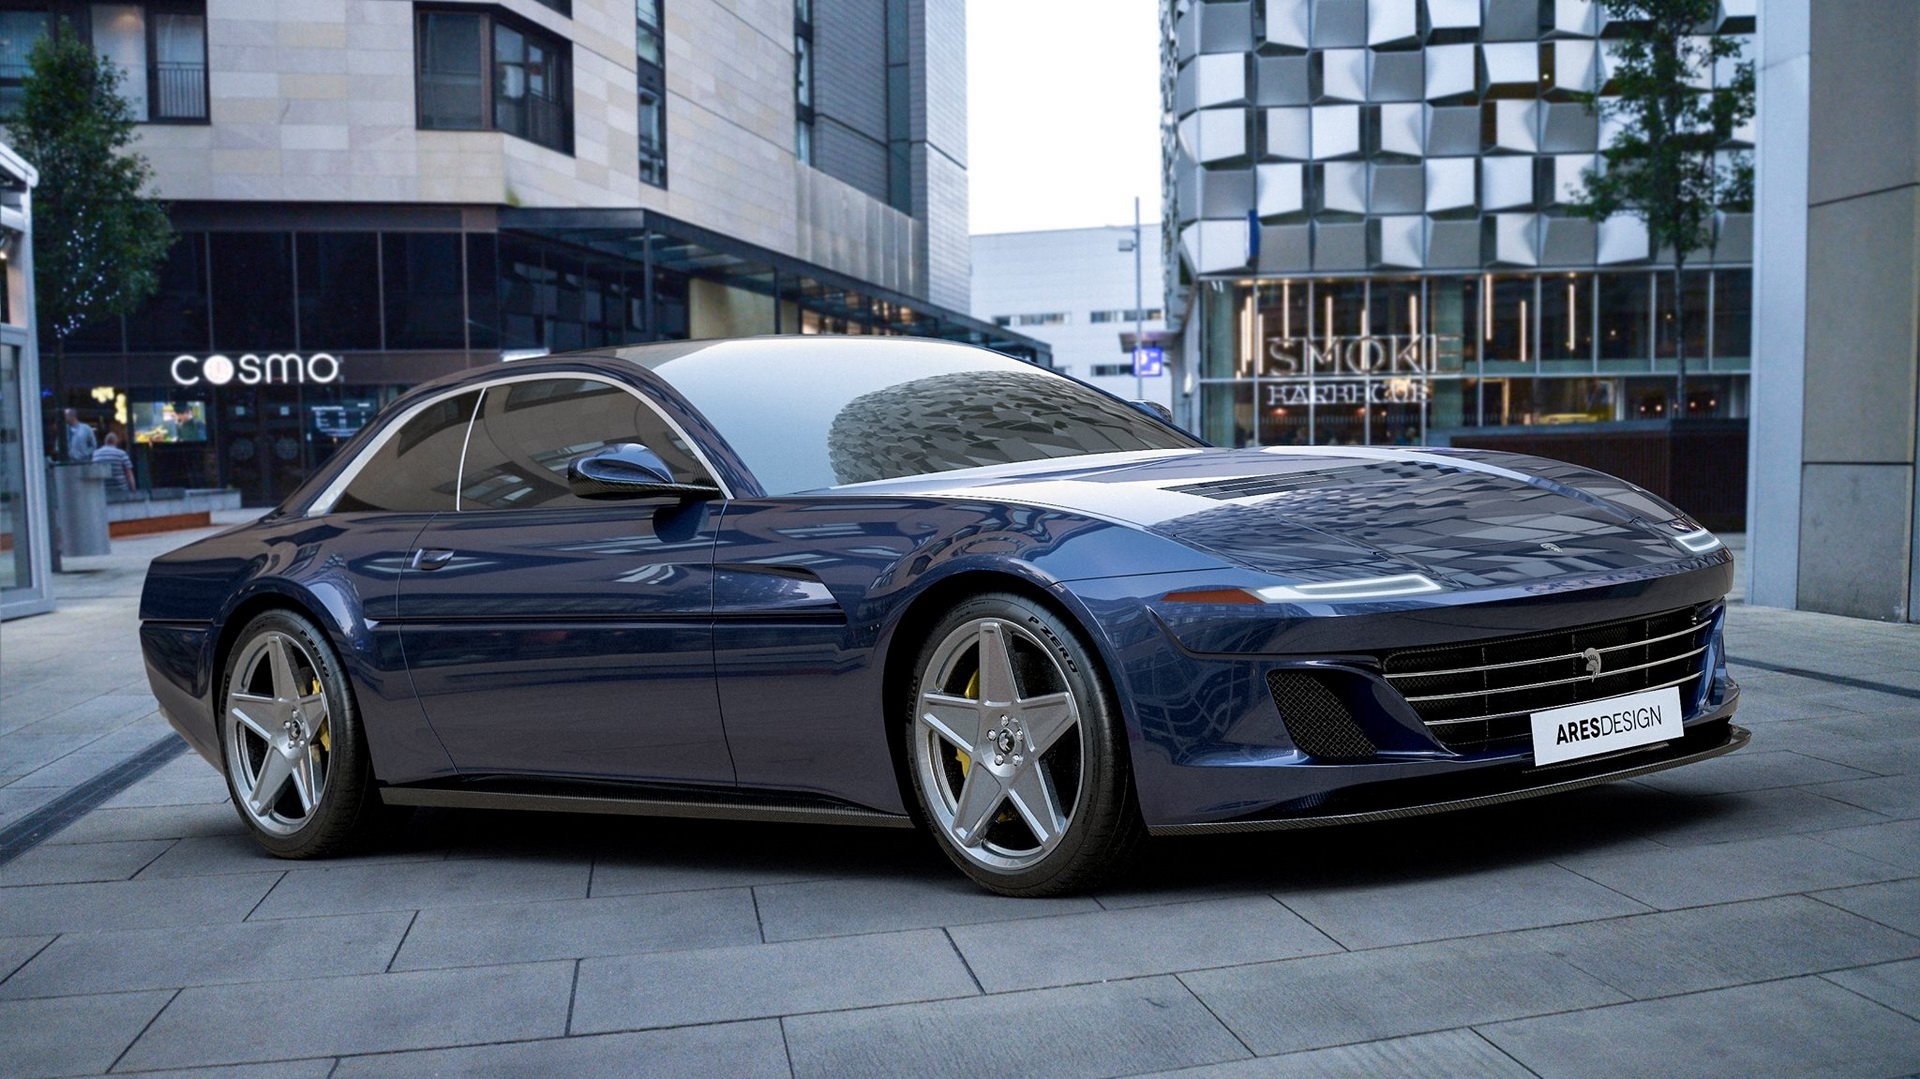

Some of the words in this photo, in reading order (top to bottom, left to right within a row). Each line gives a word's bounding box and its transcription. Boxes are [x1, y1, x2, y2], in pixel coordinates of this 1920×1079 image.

[1266, 334, 1464, 376] SMOKE
[1028, 616, 1039, 624] P
[1040, 625, 1078, 673] ZERO
[1556, 705, 1662, 745] ARESDESIGN
